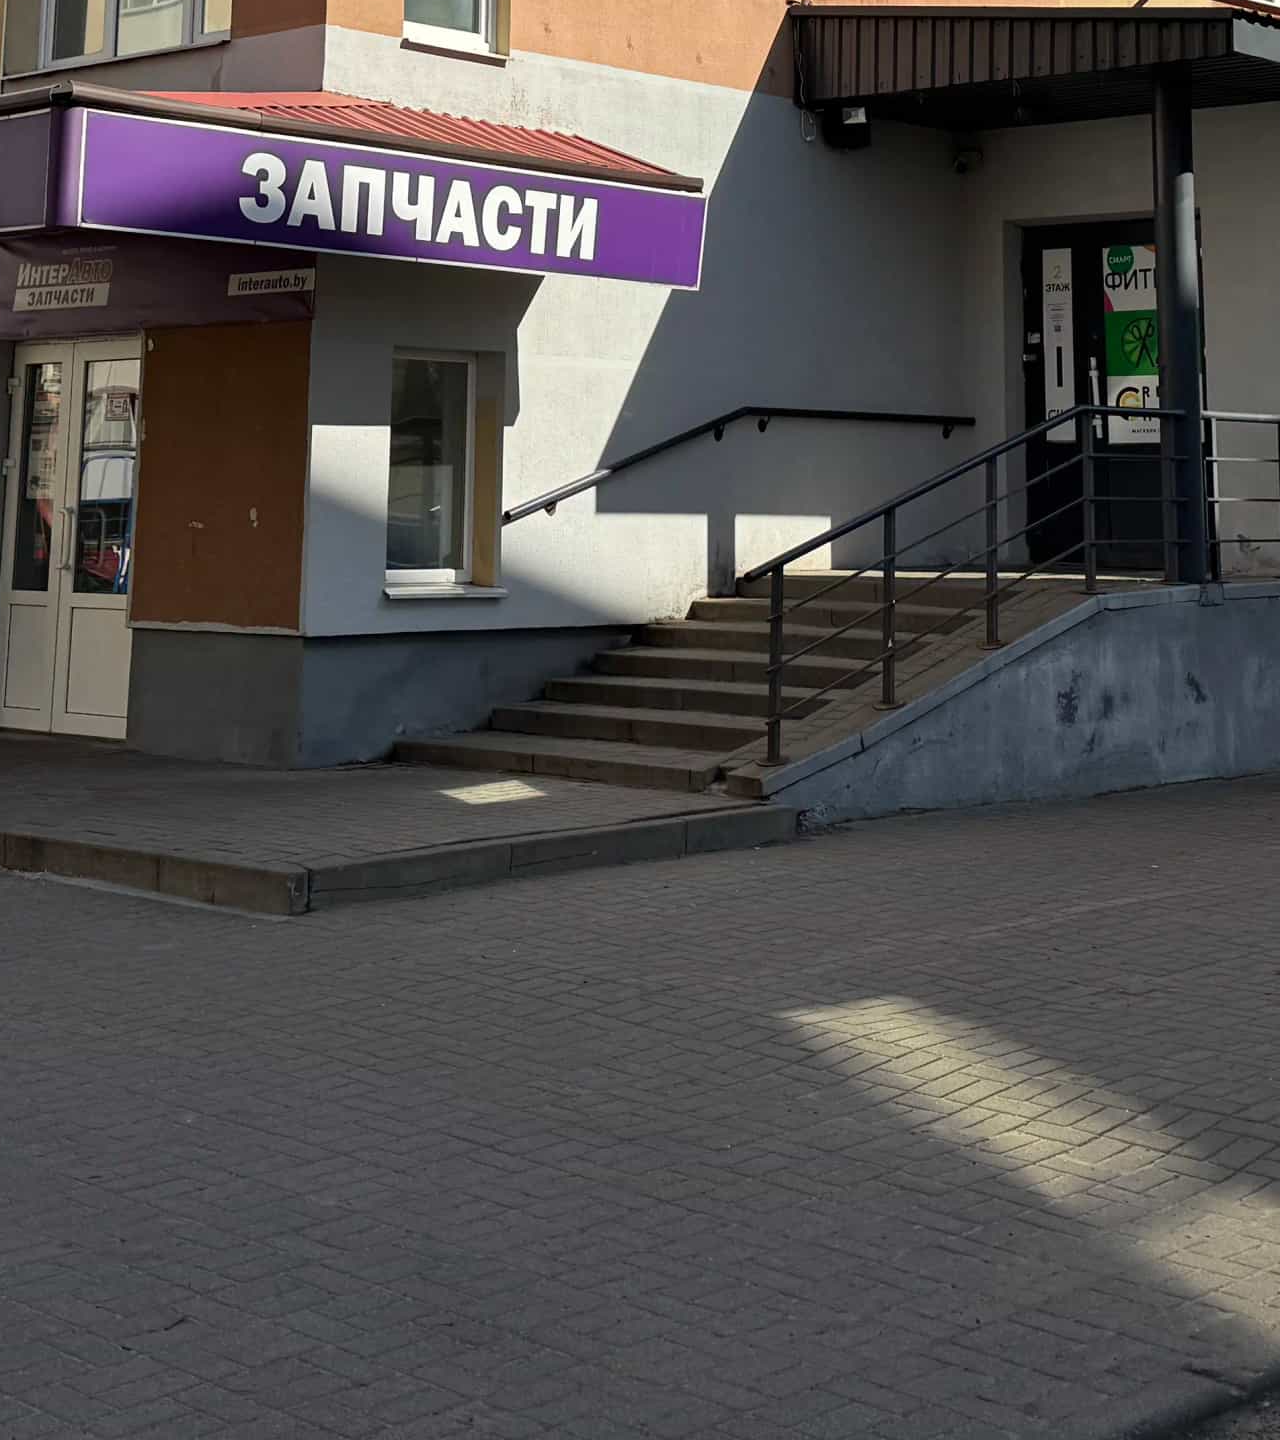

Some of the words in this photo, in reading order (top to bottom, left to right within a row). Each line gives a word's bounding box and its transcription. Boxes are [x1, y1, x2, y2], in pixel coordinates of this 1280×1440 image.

[239, 151, 598, 261] ЗАПЧАСТИ
[237, 275, 308, 292] interauto.by
[1045, 283, 1070, 293] ЭТАЖ
[27, 287, 95, 306] ЗАПЧАСТИ
